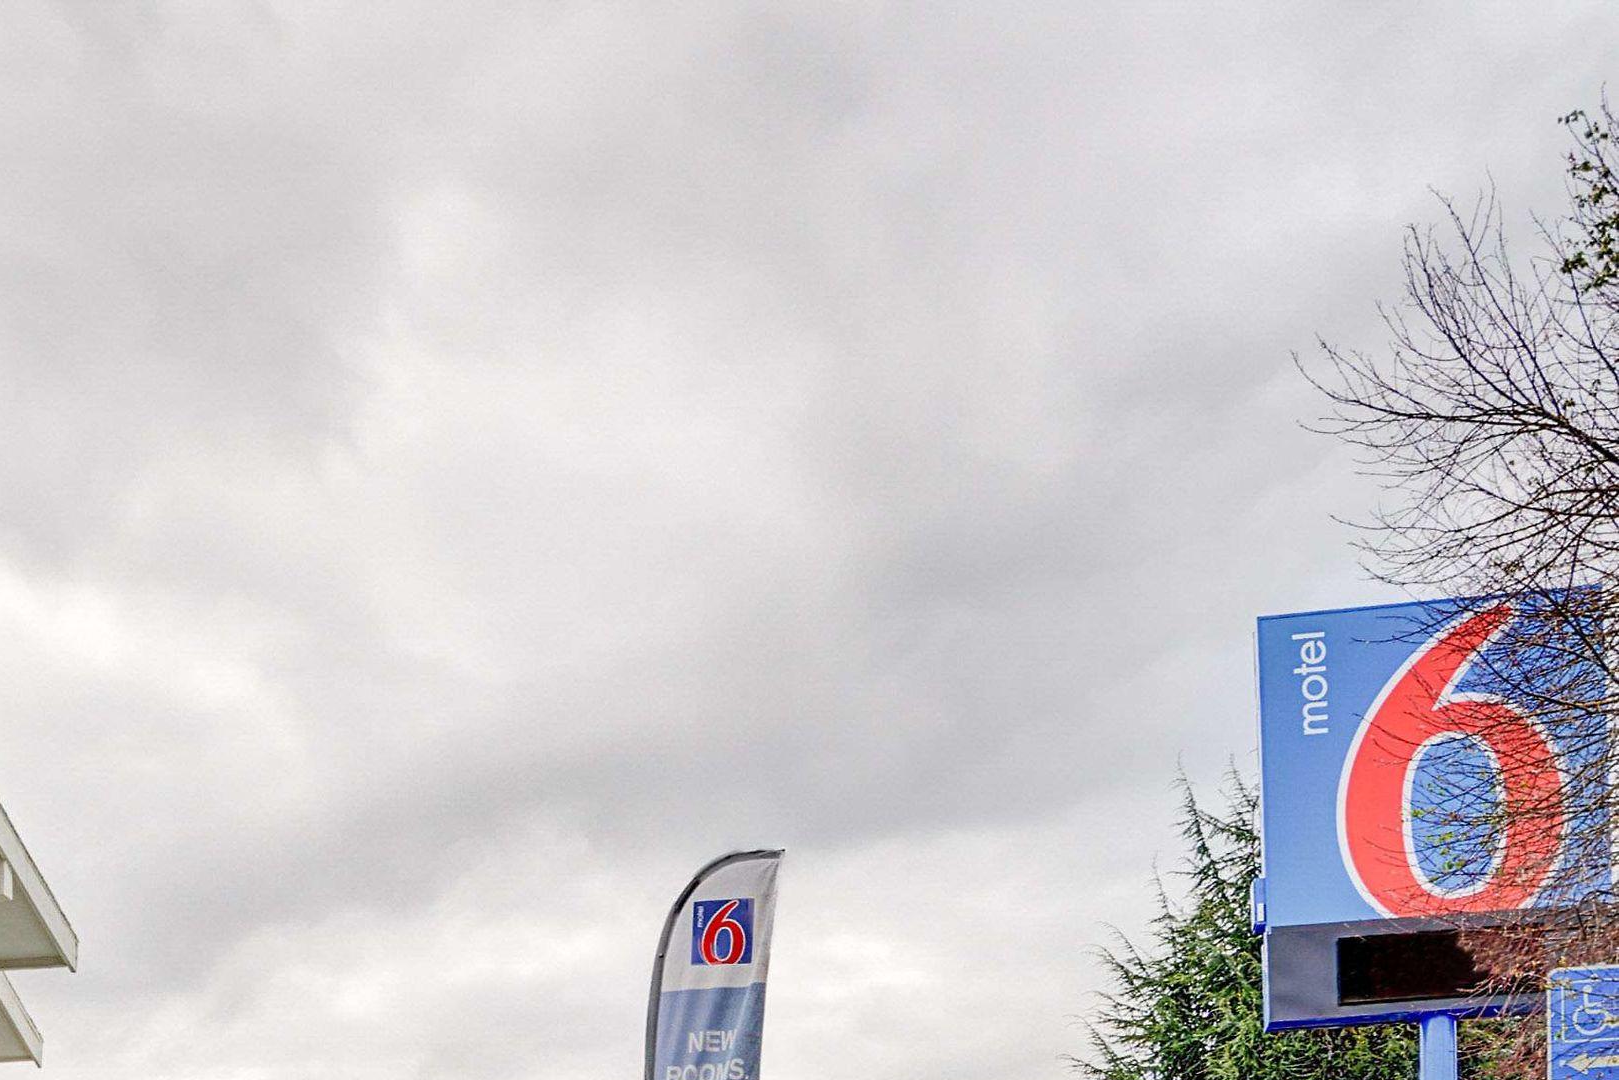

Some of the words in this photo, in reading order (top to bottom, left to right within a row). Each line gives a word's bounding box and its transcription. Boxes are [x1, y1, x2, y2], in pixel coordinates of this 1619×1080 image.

[1292, 630, 1329, 736] motel
[1336, 599, 1568, 918] 6
[701, 899, 745, 966] 6
[689, 1029, 738, 1053] NEW
